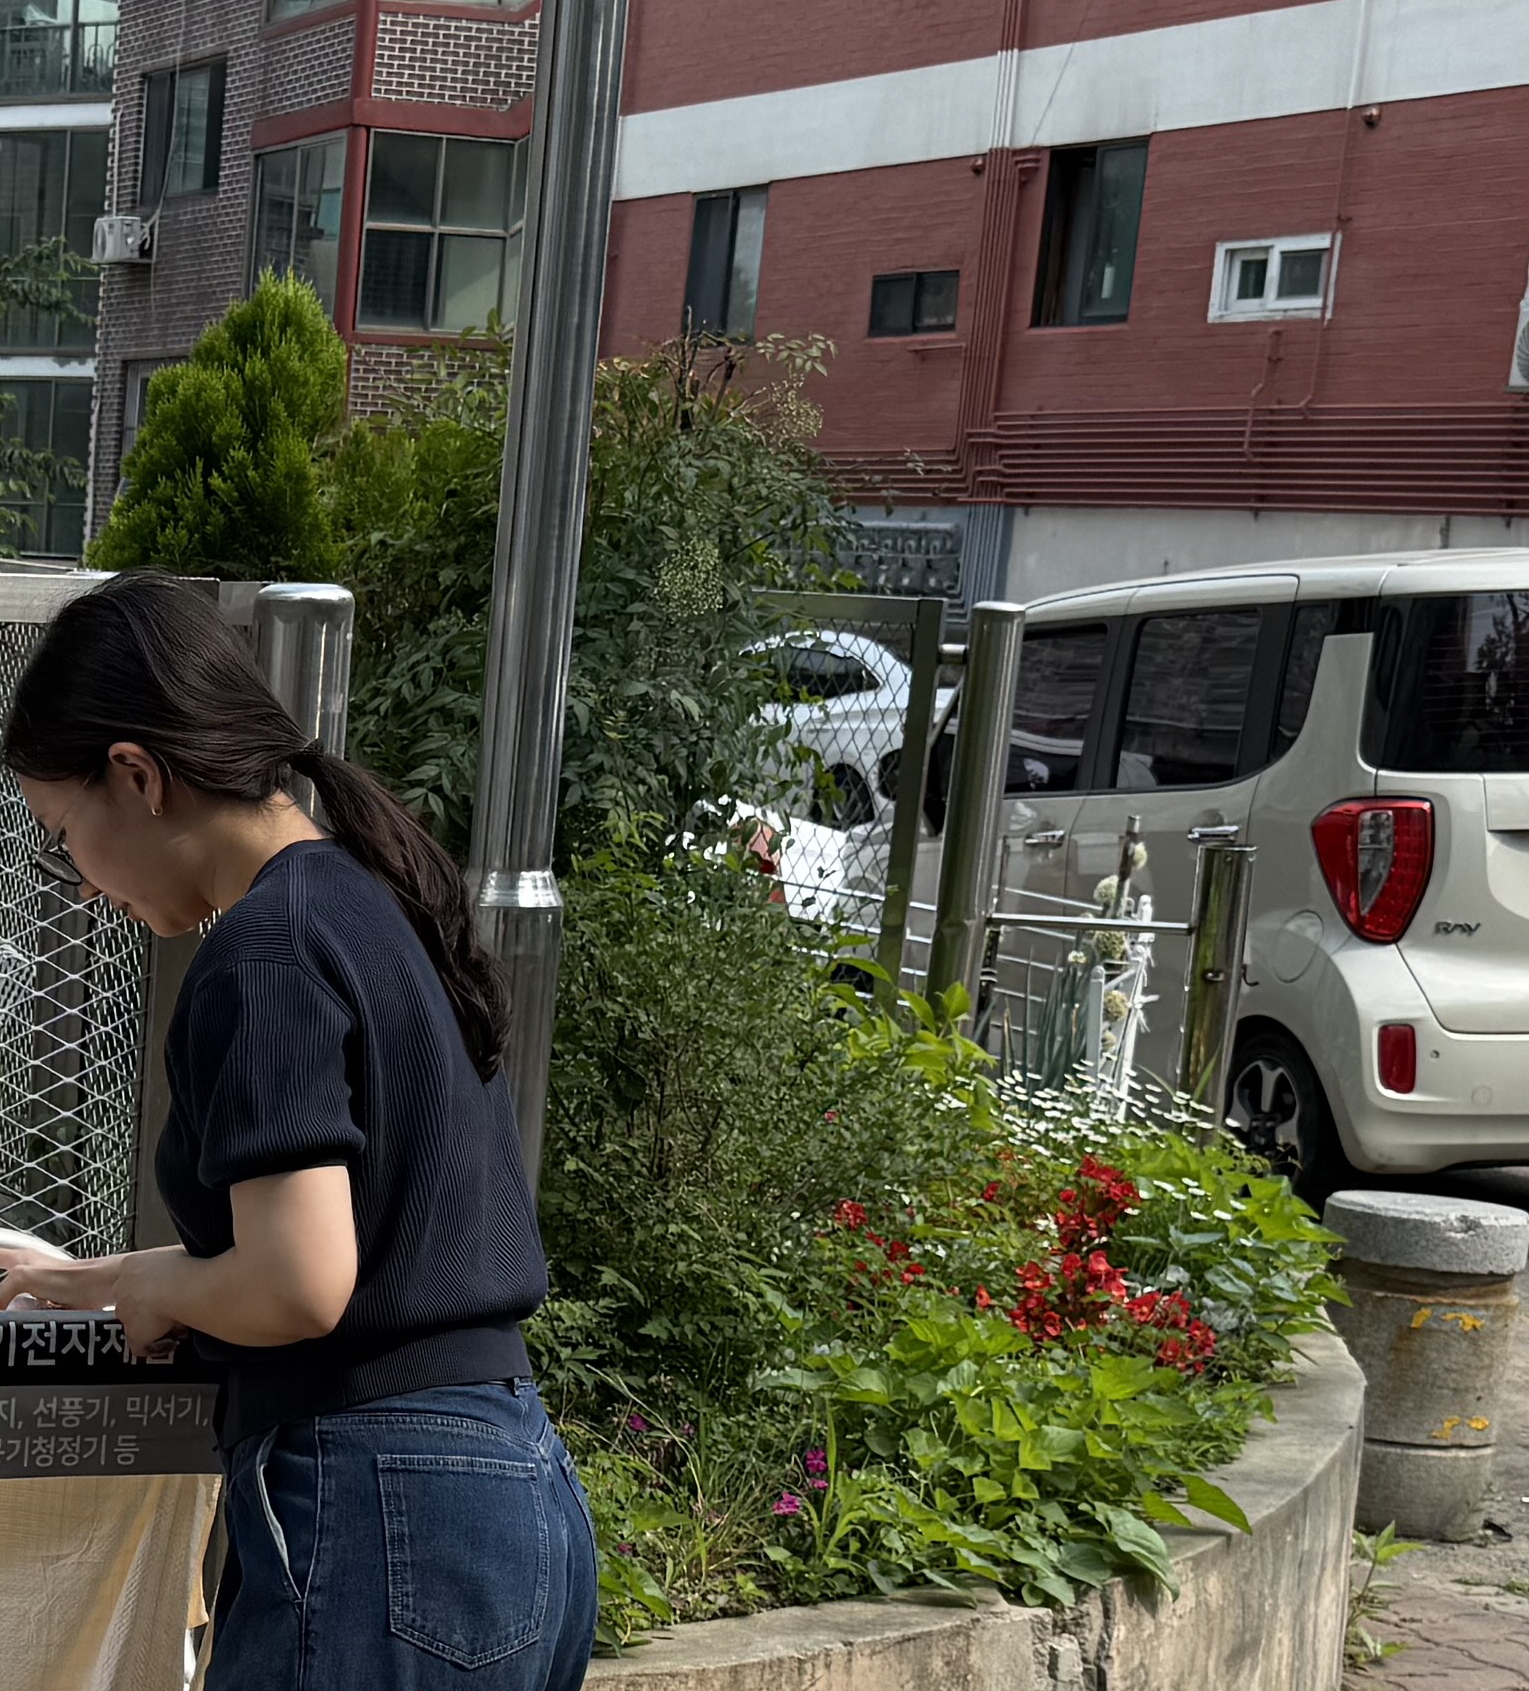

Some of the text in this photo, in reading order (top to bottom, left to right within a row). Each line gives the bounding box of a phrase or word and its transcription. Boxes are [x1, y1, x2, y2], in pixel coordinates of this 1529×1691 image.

[33, 1396, 116, 1429] 선풍기,
[126, 1395, 209, 1427] 믹서기,
[114, 1435, 139, 1466] 등
